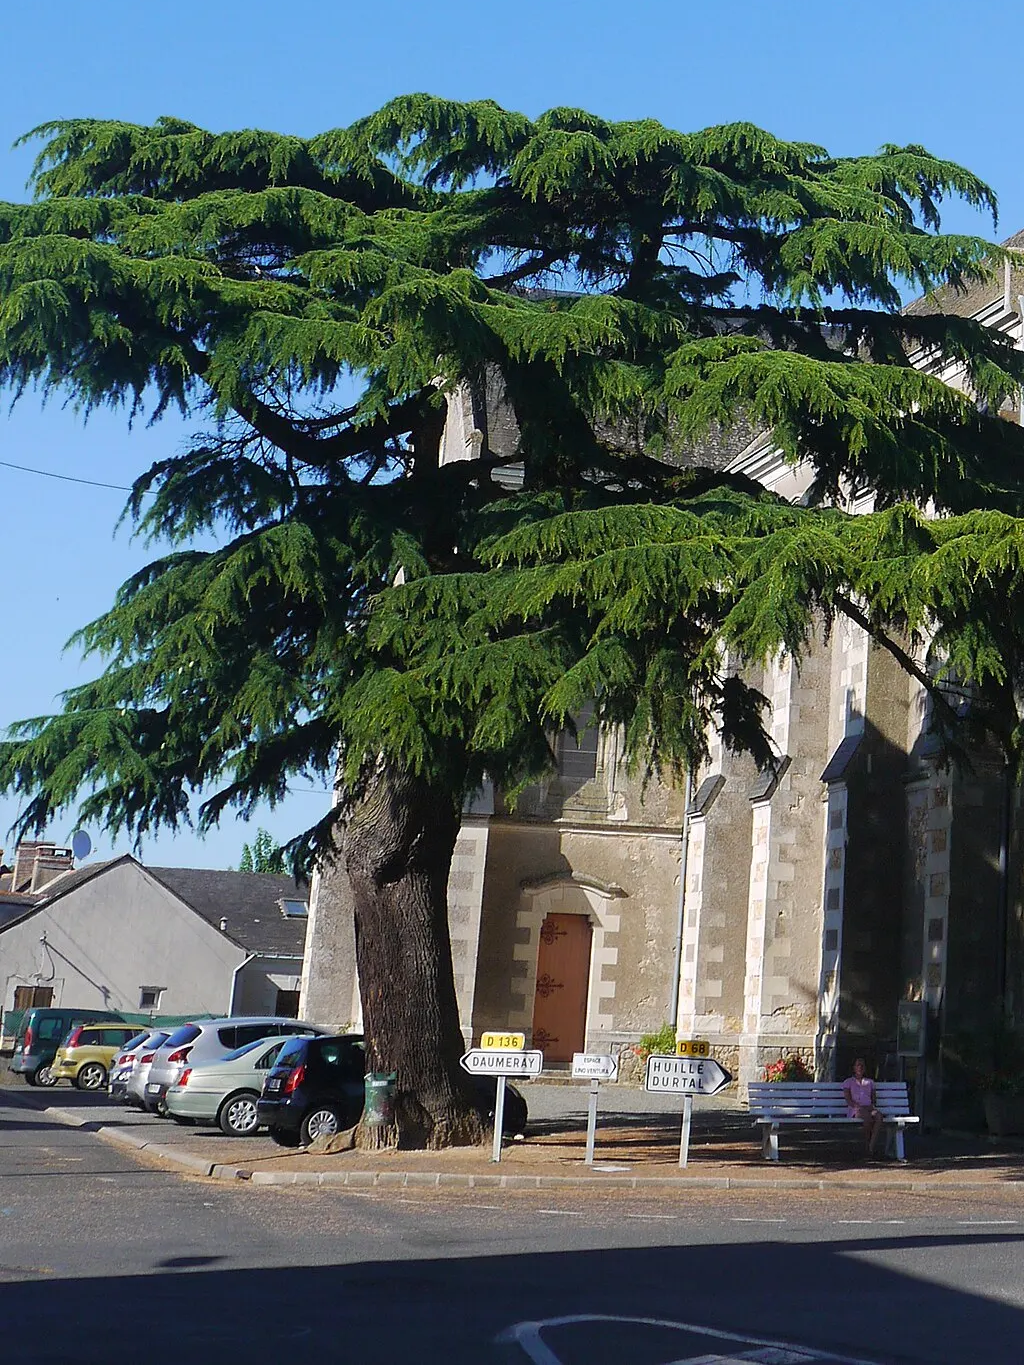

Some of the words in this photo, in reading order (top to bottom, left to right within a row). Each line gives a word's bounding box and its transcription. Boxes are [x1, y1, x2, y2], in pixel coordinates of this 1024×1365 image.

[487, 1036, 494, 1047] D
[498, 1036, 519, 1048] 136
[680, 1042, 688, 1053] D
[691, 1043, 706, 1054] 68
[472, 1056, 535, 1068] DAUMERAY
[653, 1061, 705, 1074] HUILLÉ
[652, 1076, 704, 1089] DURTAL
